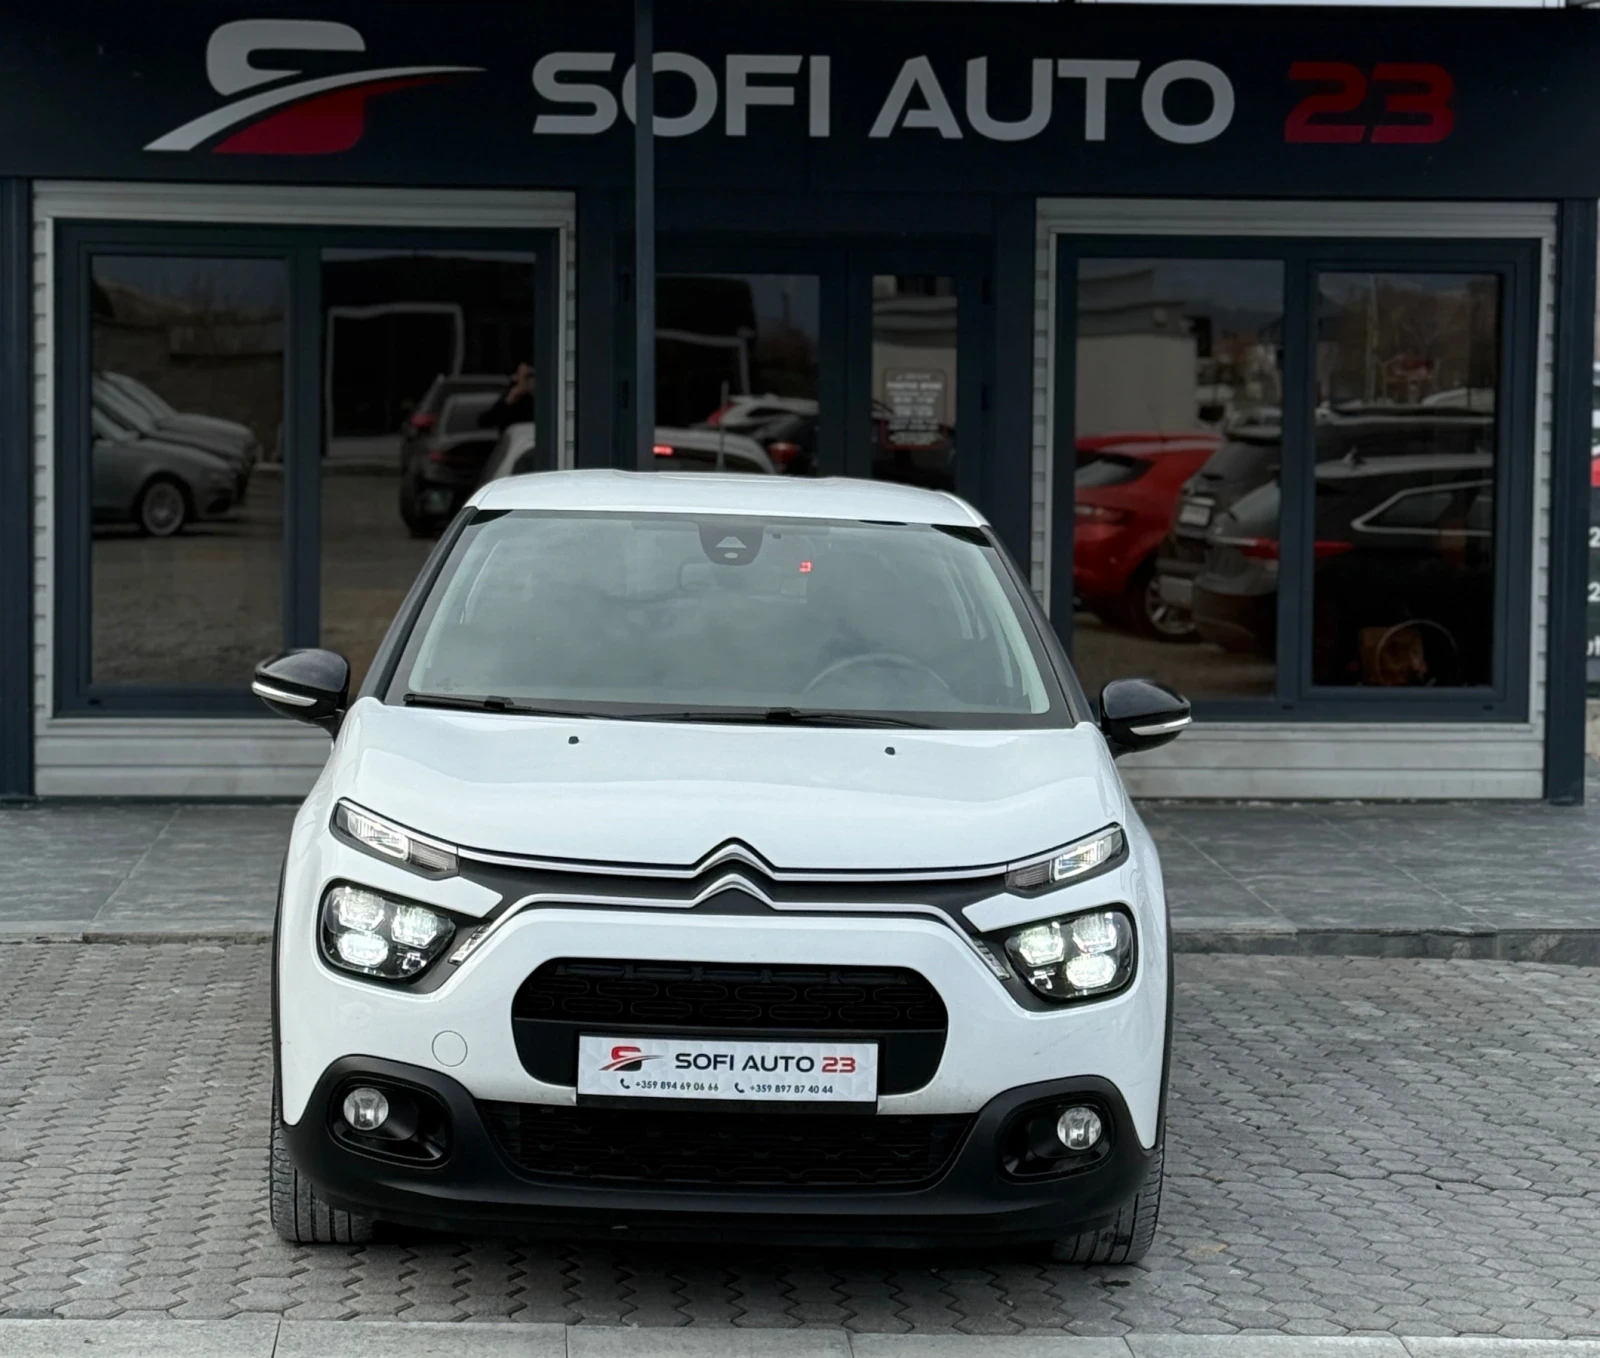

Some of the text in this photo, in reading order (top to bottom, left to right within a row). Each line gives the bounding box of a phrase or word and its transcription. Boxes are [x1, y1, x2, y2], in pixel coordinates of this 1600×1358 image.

[532, 52, 1456, 145] SOFI AUTO 23
[675, 1053, 856, 1073] SOFI AUTO 23
[635, 1080, 719, 1092] +359 894 69 06 66
[750, 1084, 833, 1094] +359 897 87 40 44
